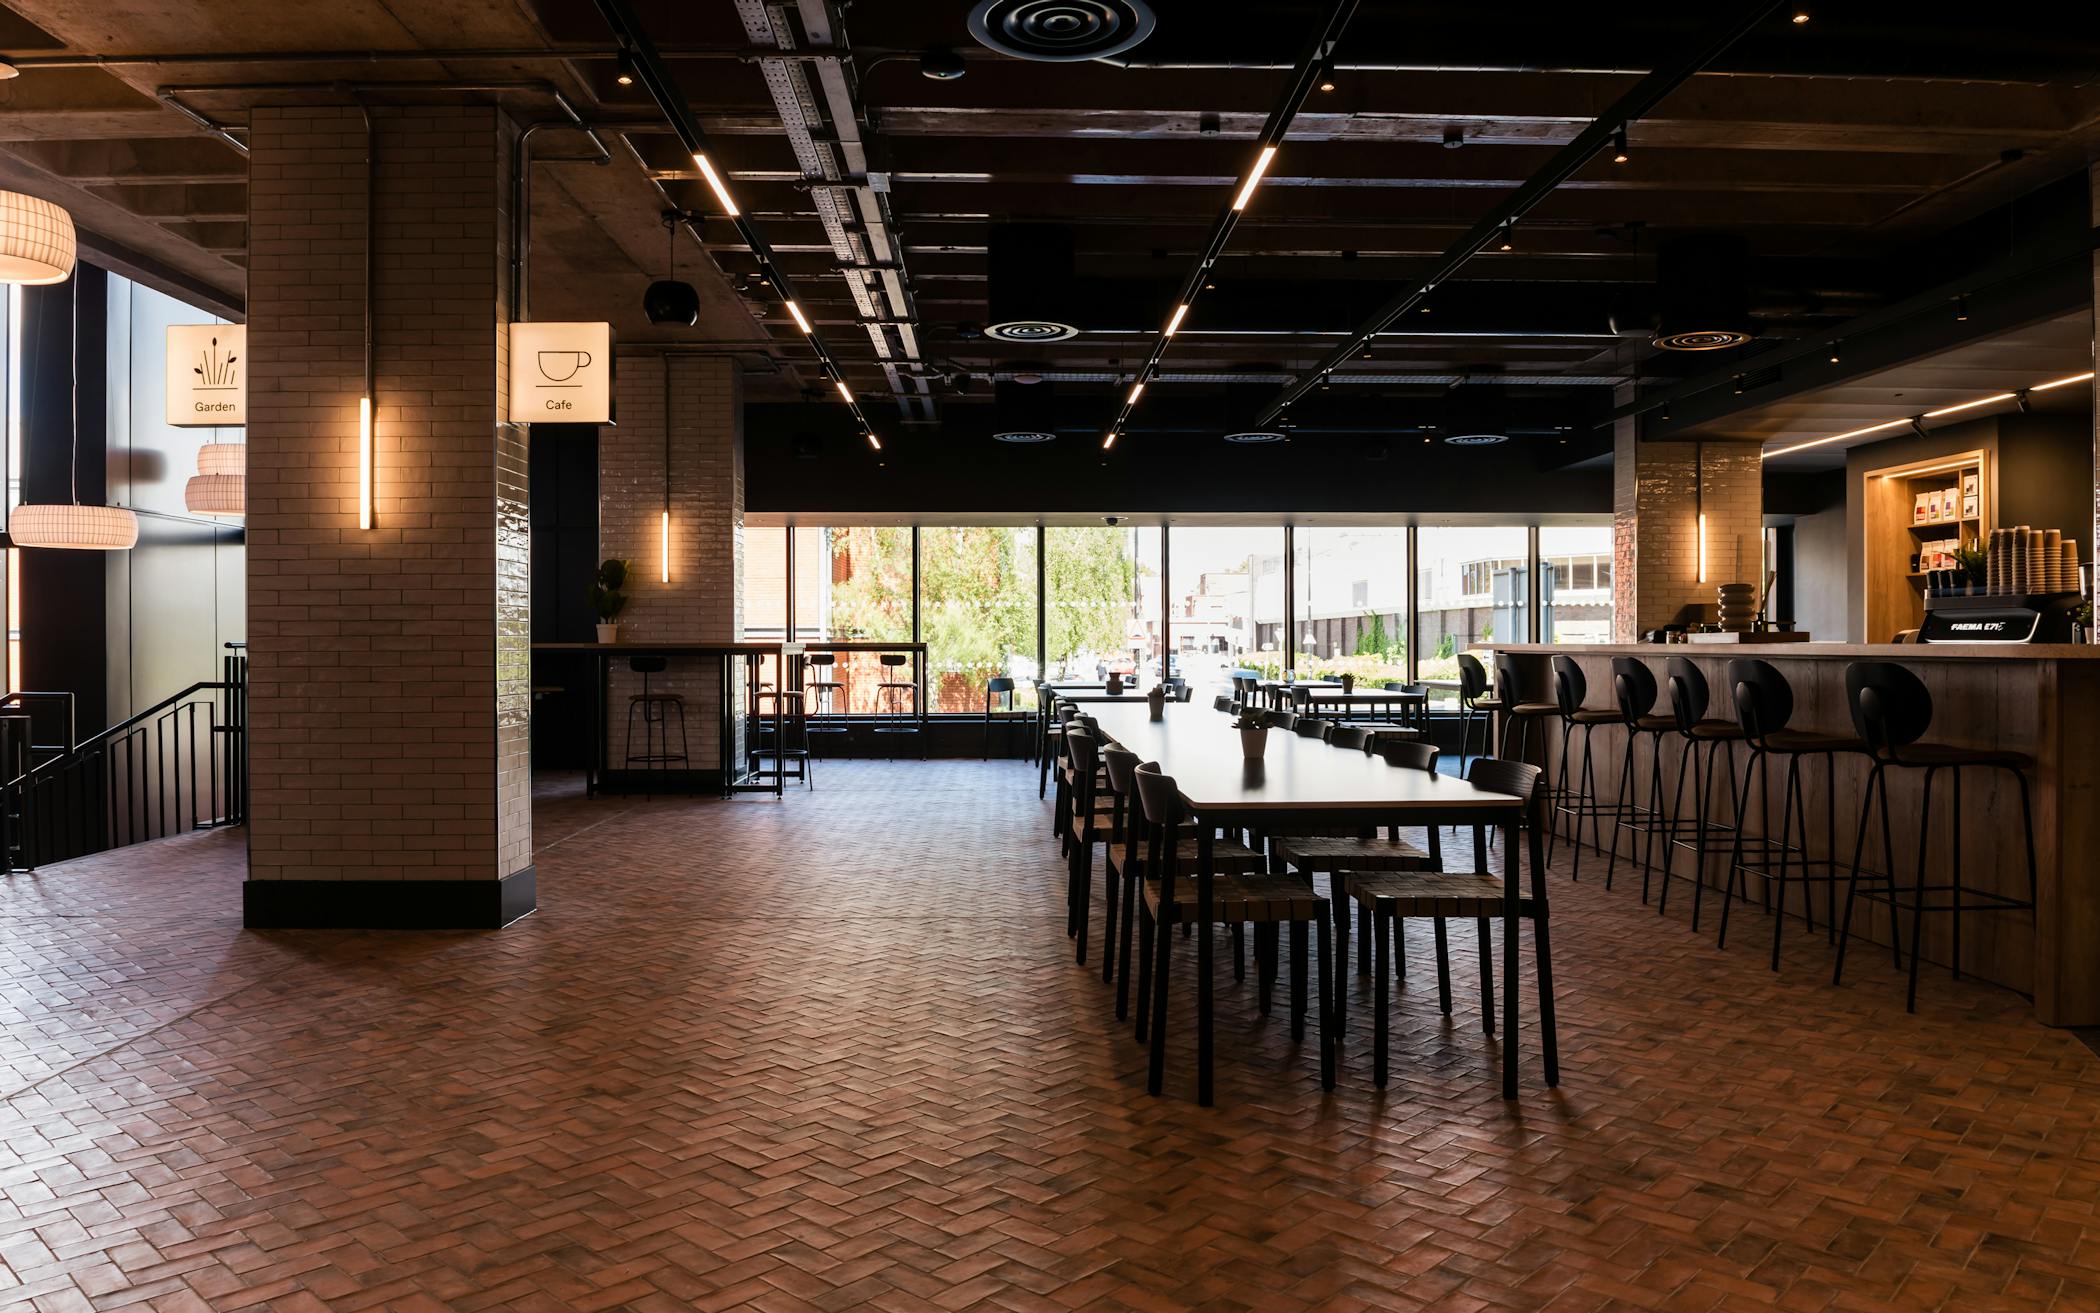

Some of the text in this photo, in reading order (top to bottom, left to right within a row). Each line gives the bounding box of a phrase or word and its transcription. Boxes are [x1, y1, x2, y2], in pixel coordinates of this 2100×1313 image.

[195, 401, 236, 412] Garden
[545, 399, 572, 410] Cafe
[1950, 622, 1982, 631] FAEMA
